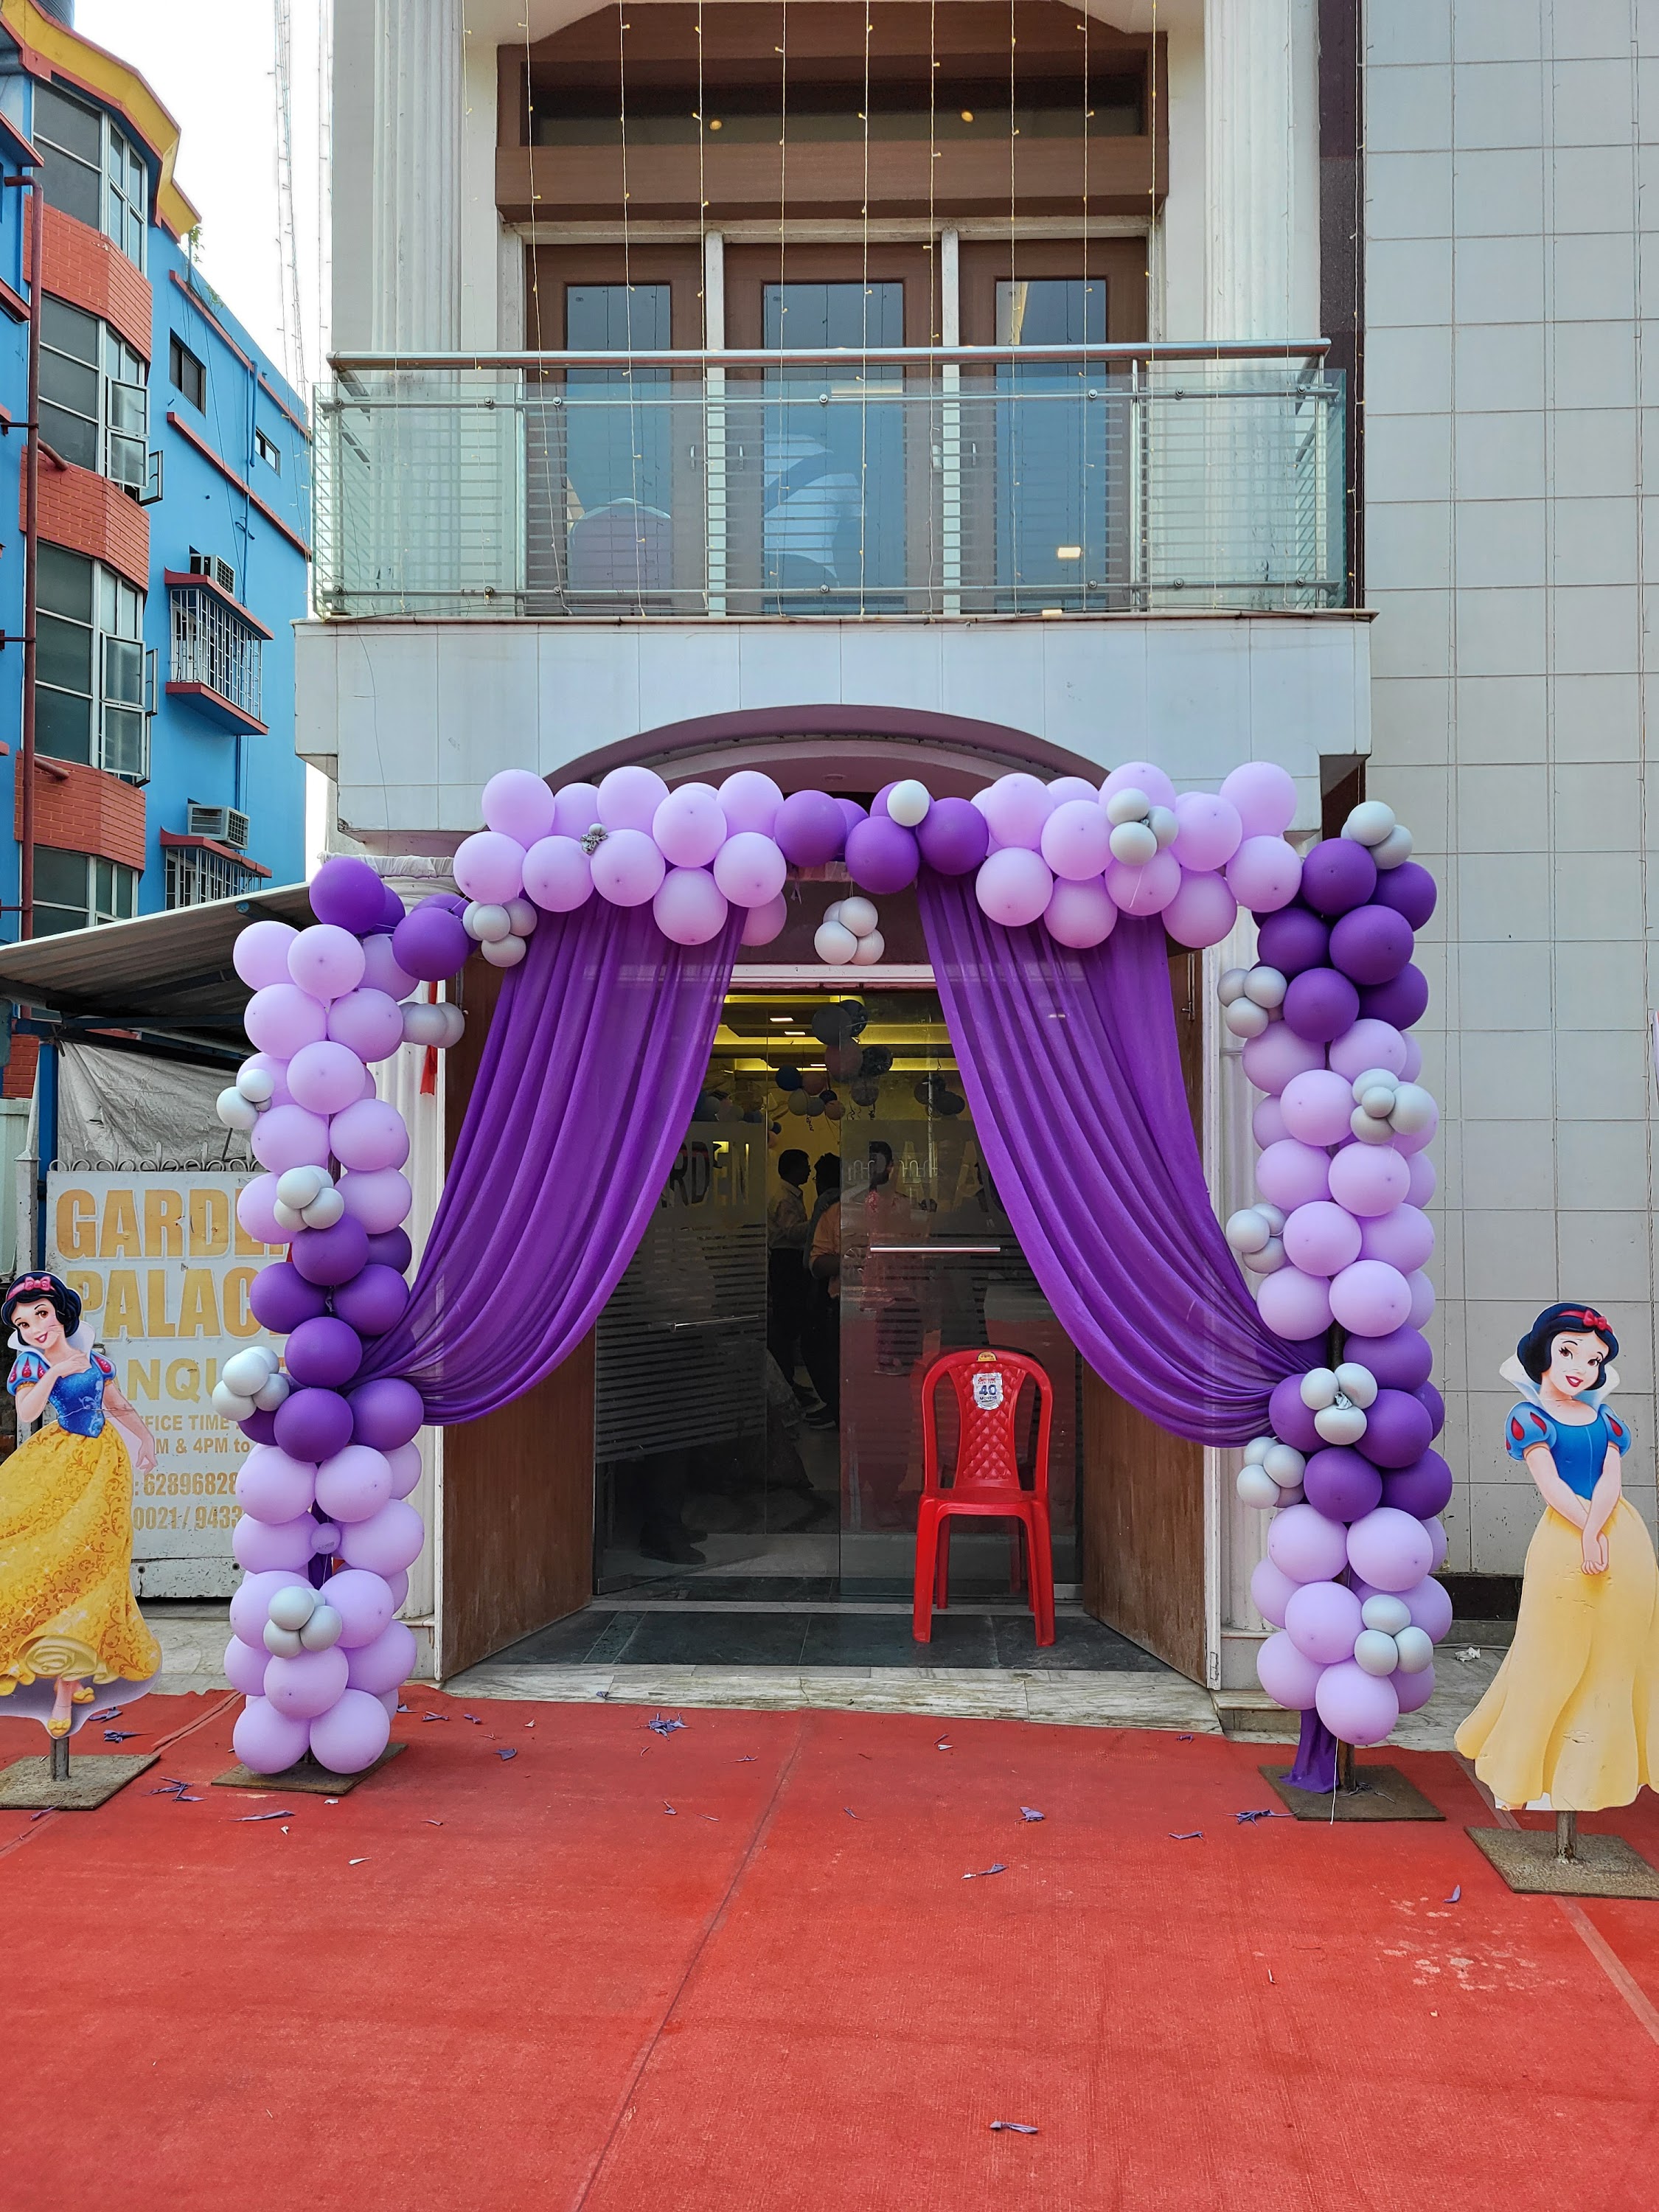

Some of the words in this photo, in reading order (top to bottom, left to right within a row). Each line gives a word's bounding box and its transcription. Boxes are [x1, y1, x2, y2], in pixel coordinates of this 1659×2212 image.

[66, 1267, 292, 1337] PALAC
[978, 1385, 997, 1396] 40
[175, 1438, 187, 1454] &
[193, 1437, 228, 1453] 4PM
[234, 1438, 251, 1453] to
